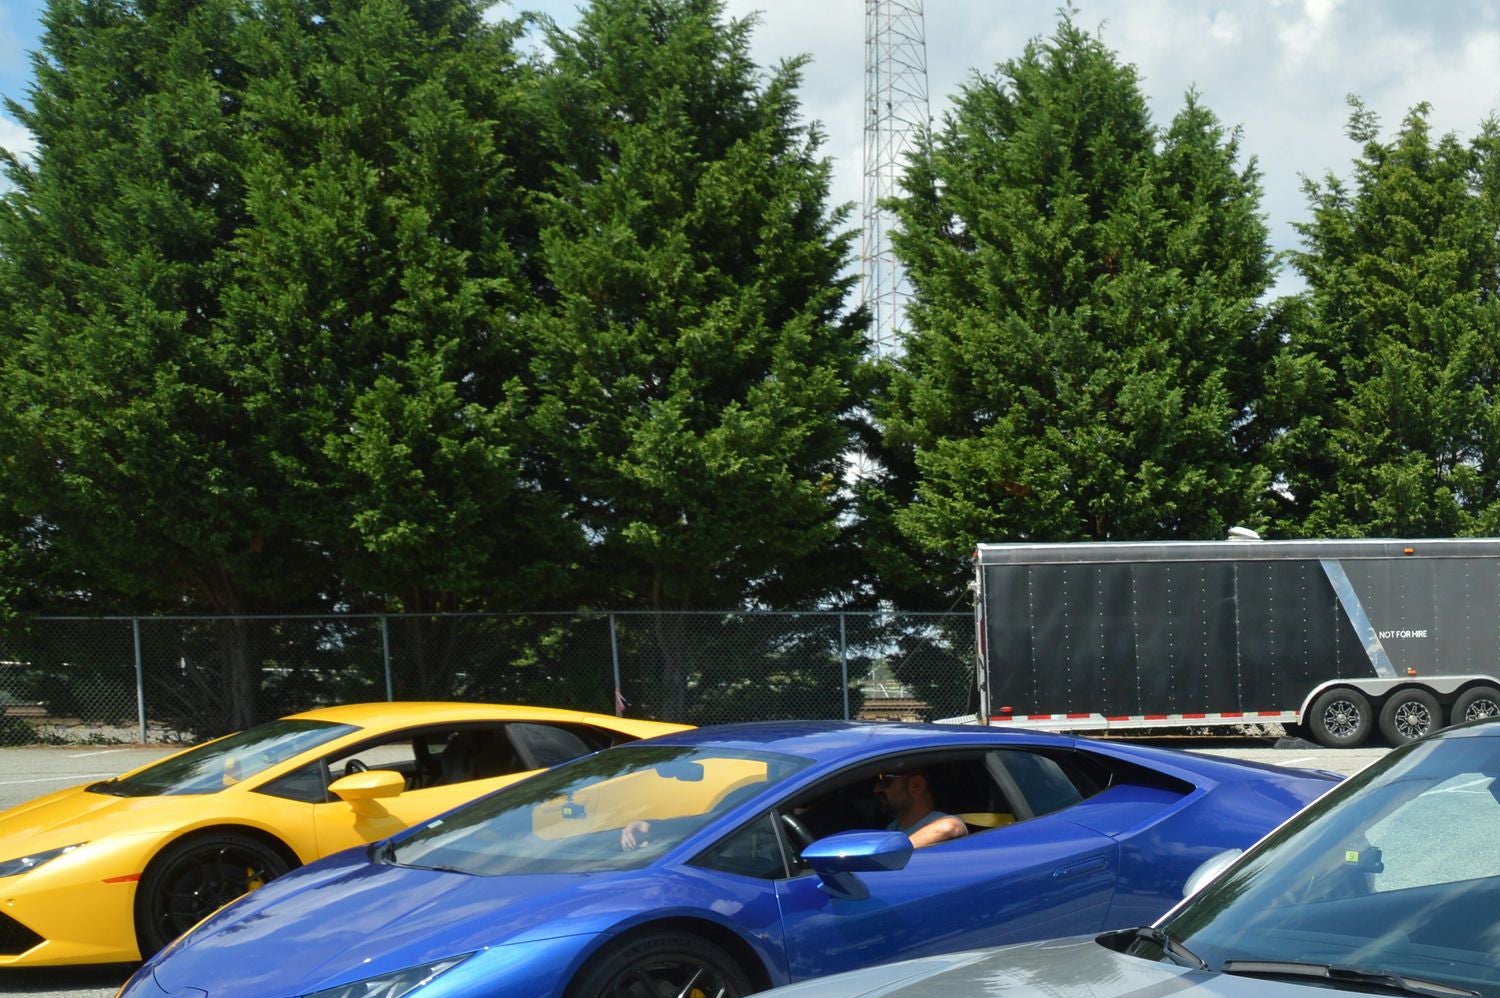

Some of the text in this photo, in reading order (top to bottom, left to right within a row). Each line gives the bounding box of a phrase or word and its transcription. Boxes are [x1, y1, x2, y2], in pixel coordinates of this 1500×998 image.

[1378, 629, 1428, 639] NOT FOR HIRE
